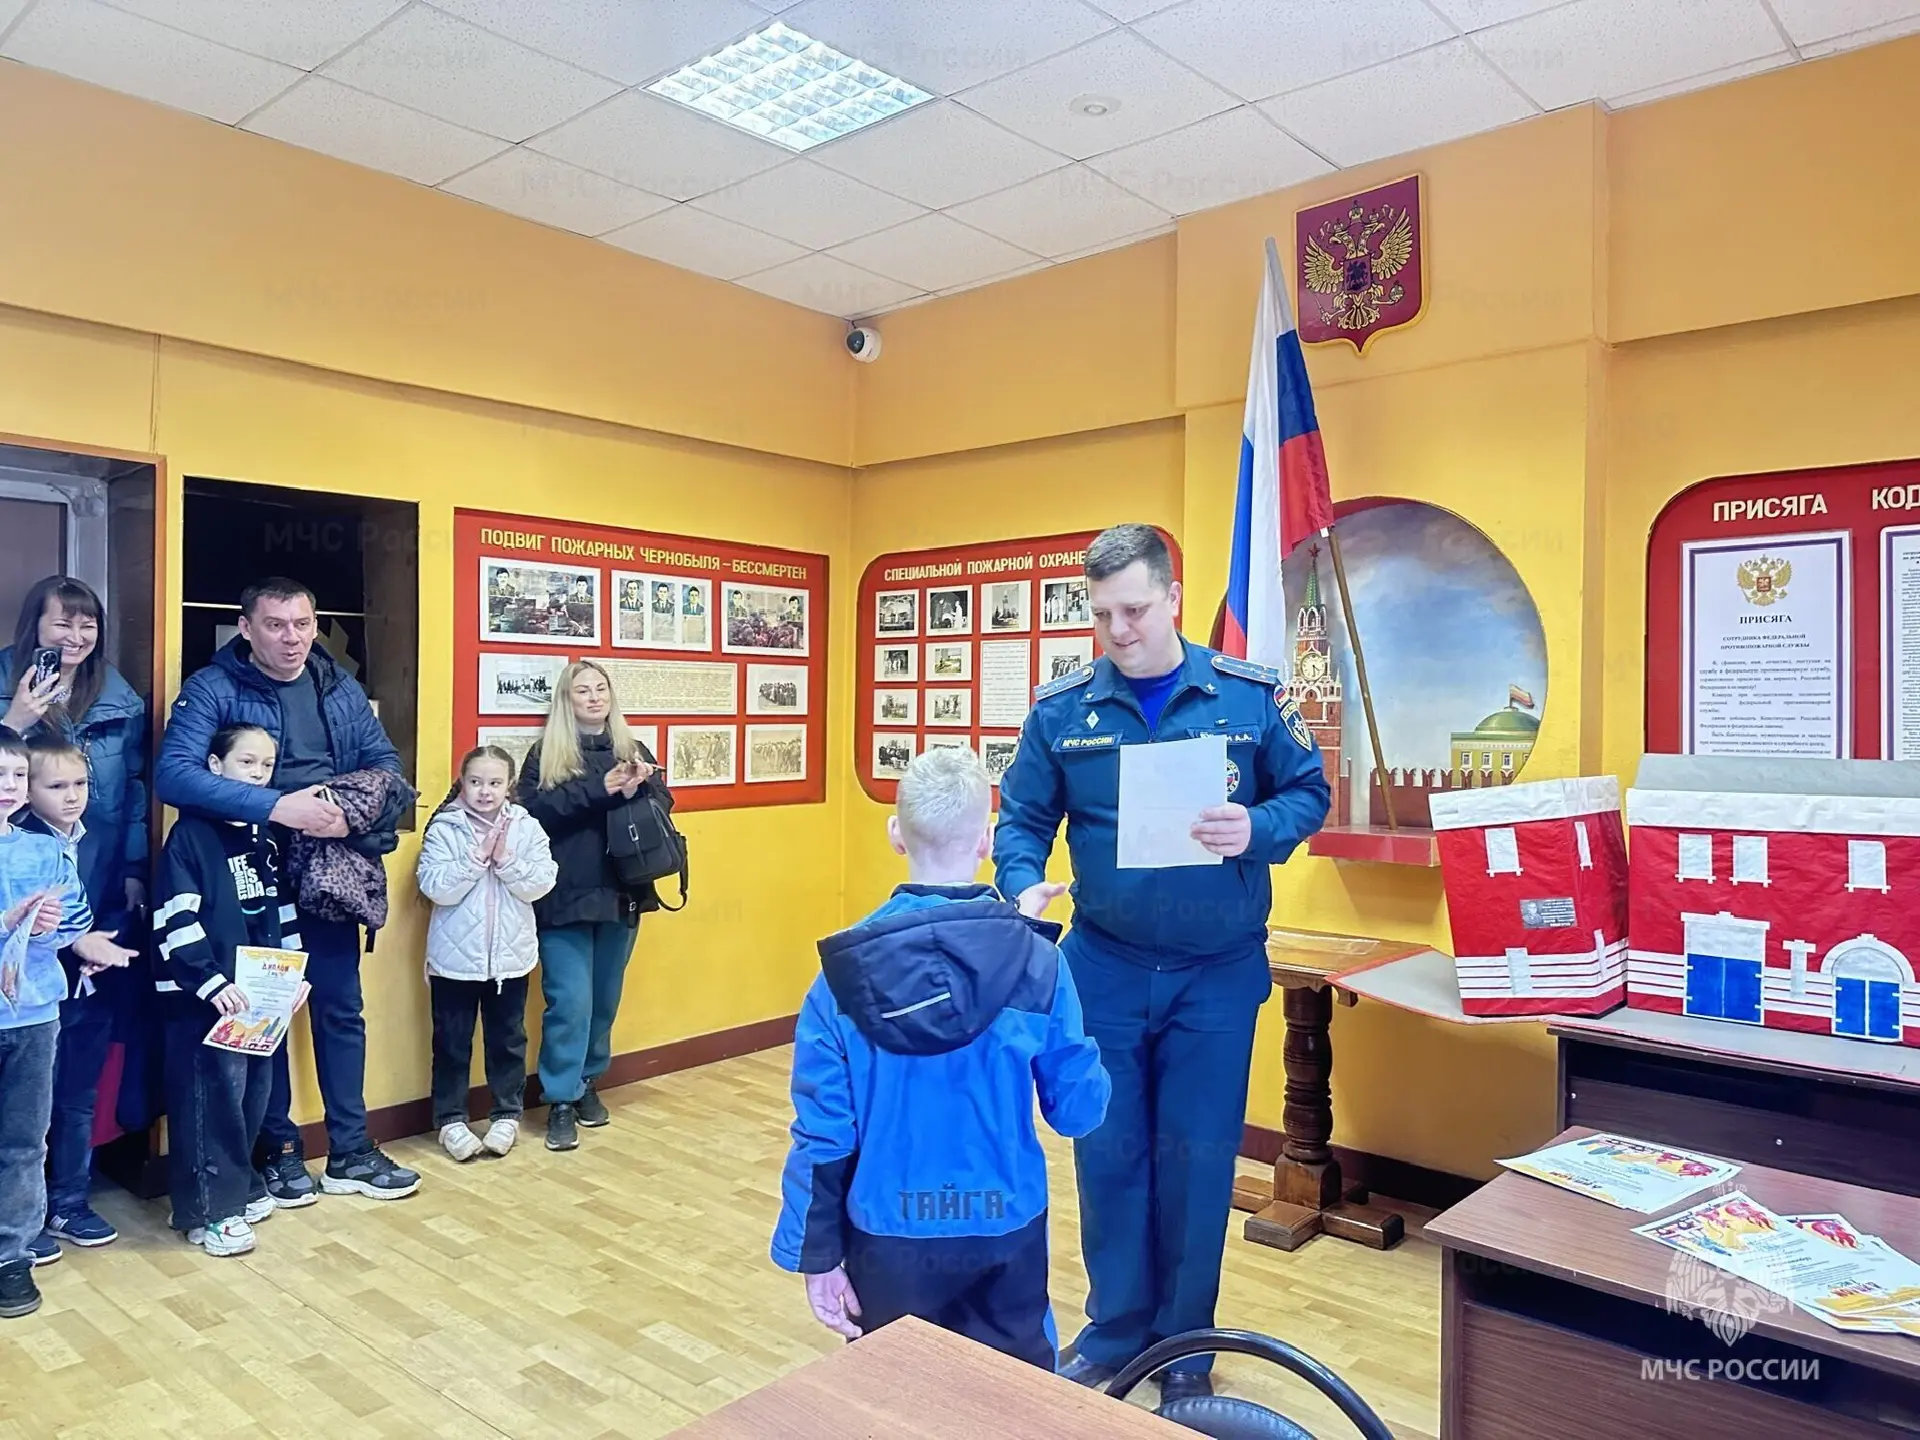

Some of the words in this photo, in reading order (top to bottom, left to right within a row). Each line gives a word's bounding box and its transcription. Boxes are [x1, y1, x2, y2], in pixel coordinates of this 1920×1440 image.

[1713, 493, 1828, 522] ПРИСЯГА
[481, 528, 545, 551] ПОДВИГ
[551, 536, 635, 561] ПОЖАРНЫХ
[640, 547, 720, 570] ЧЕРНОБЫЛЯ
[732, 558, 807, 580] БЕССМЕРТЕН
[884, 558, 962, 582] СПЕЦИАЛЬНОЙ
[967, 551, 1033, 575] ПОЖАРНОЙ
[1039, 550, 1086, 569] ОХРАНЕ
[1739, 614, 1793, 625] ПРИСЯГА
[1062, 738, 1081, 748] МЧС
[1081, 736, 1113, 747] РОССИИ
[898, 1183, 1004, 1220] ТАЙГА
